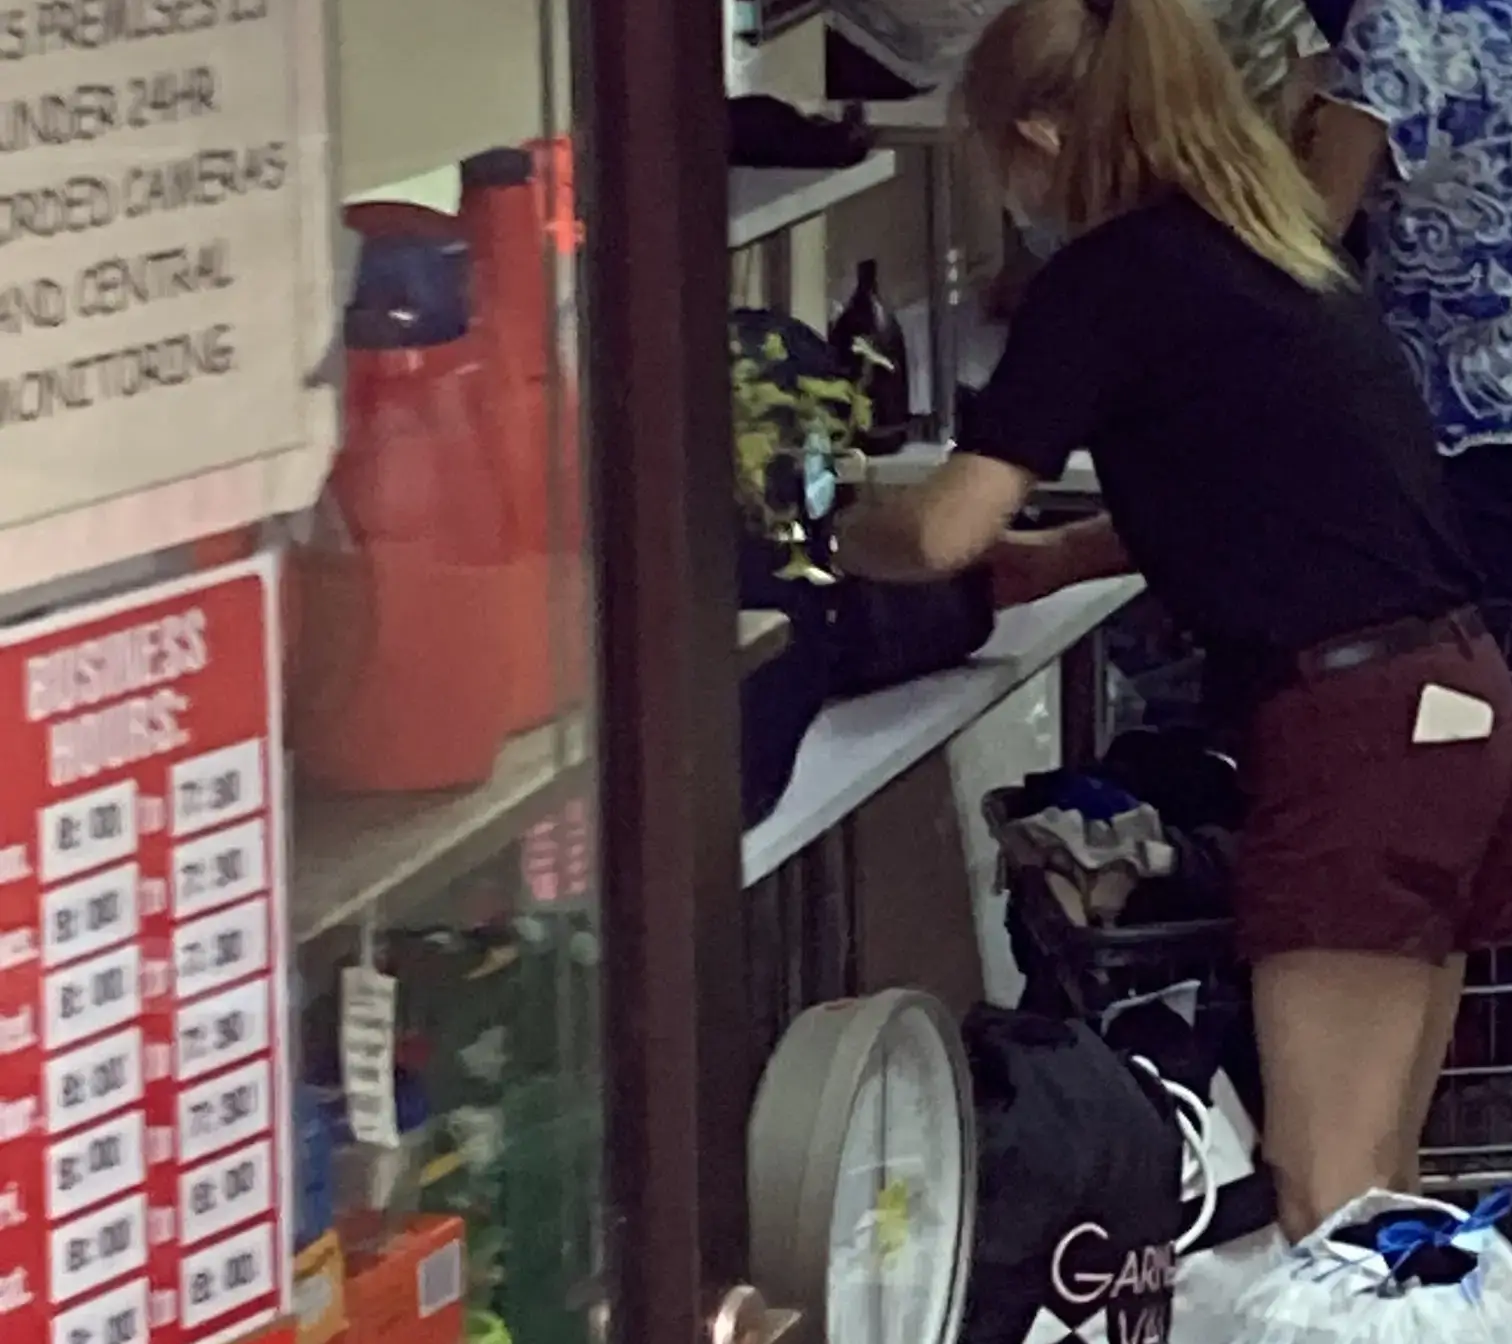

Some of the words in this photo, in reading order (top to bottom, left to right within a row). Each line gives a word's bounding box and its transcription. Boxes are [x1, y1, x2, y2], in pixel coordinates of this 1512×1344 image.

[128, 65, 219, 127] 24HR
[125, 140, 288, 219] CAMERAS
[0, 275, 67, 335] AND
[76, 237, 234, 317] CENTRAL
